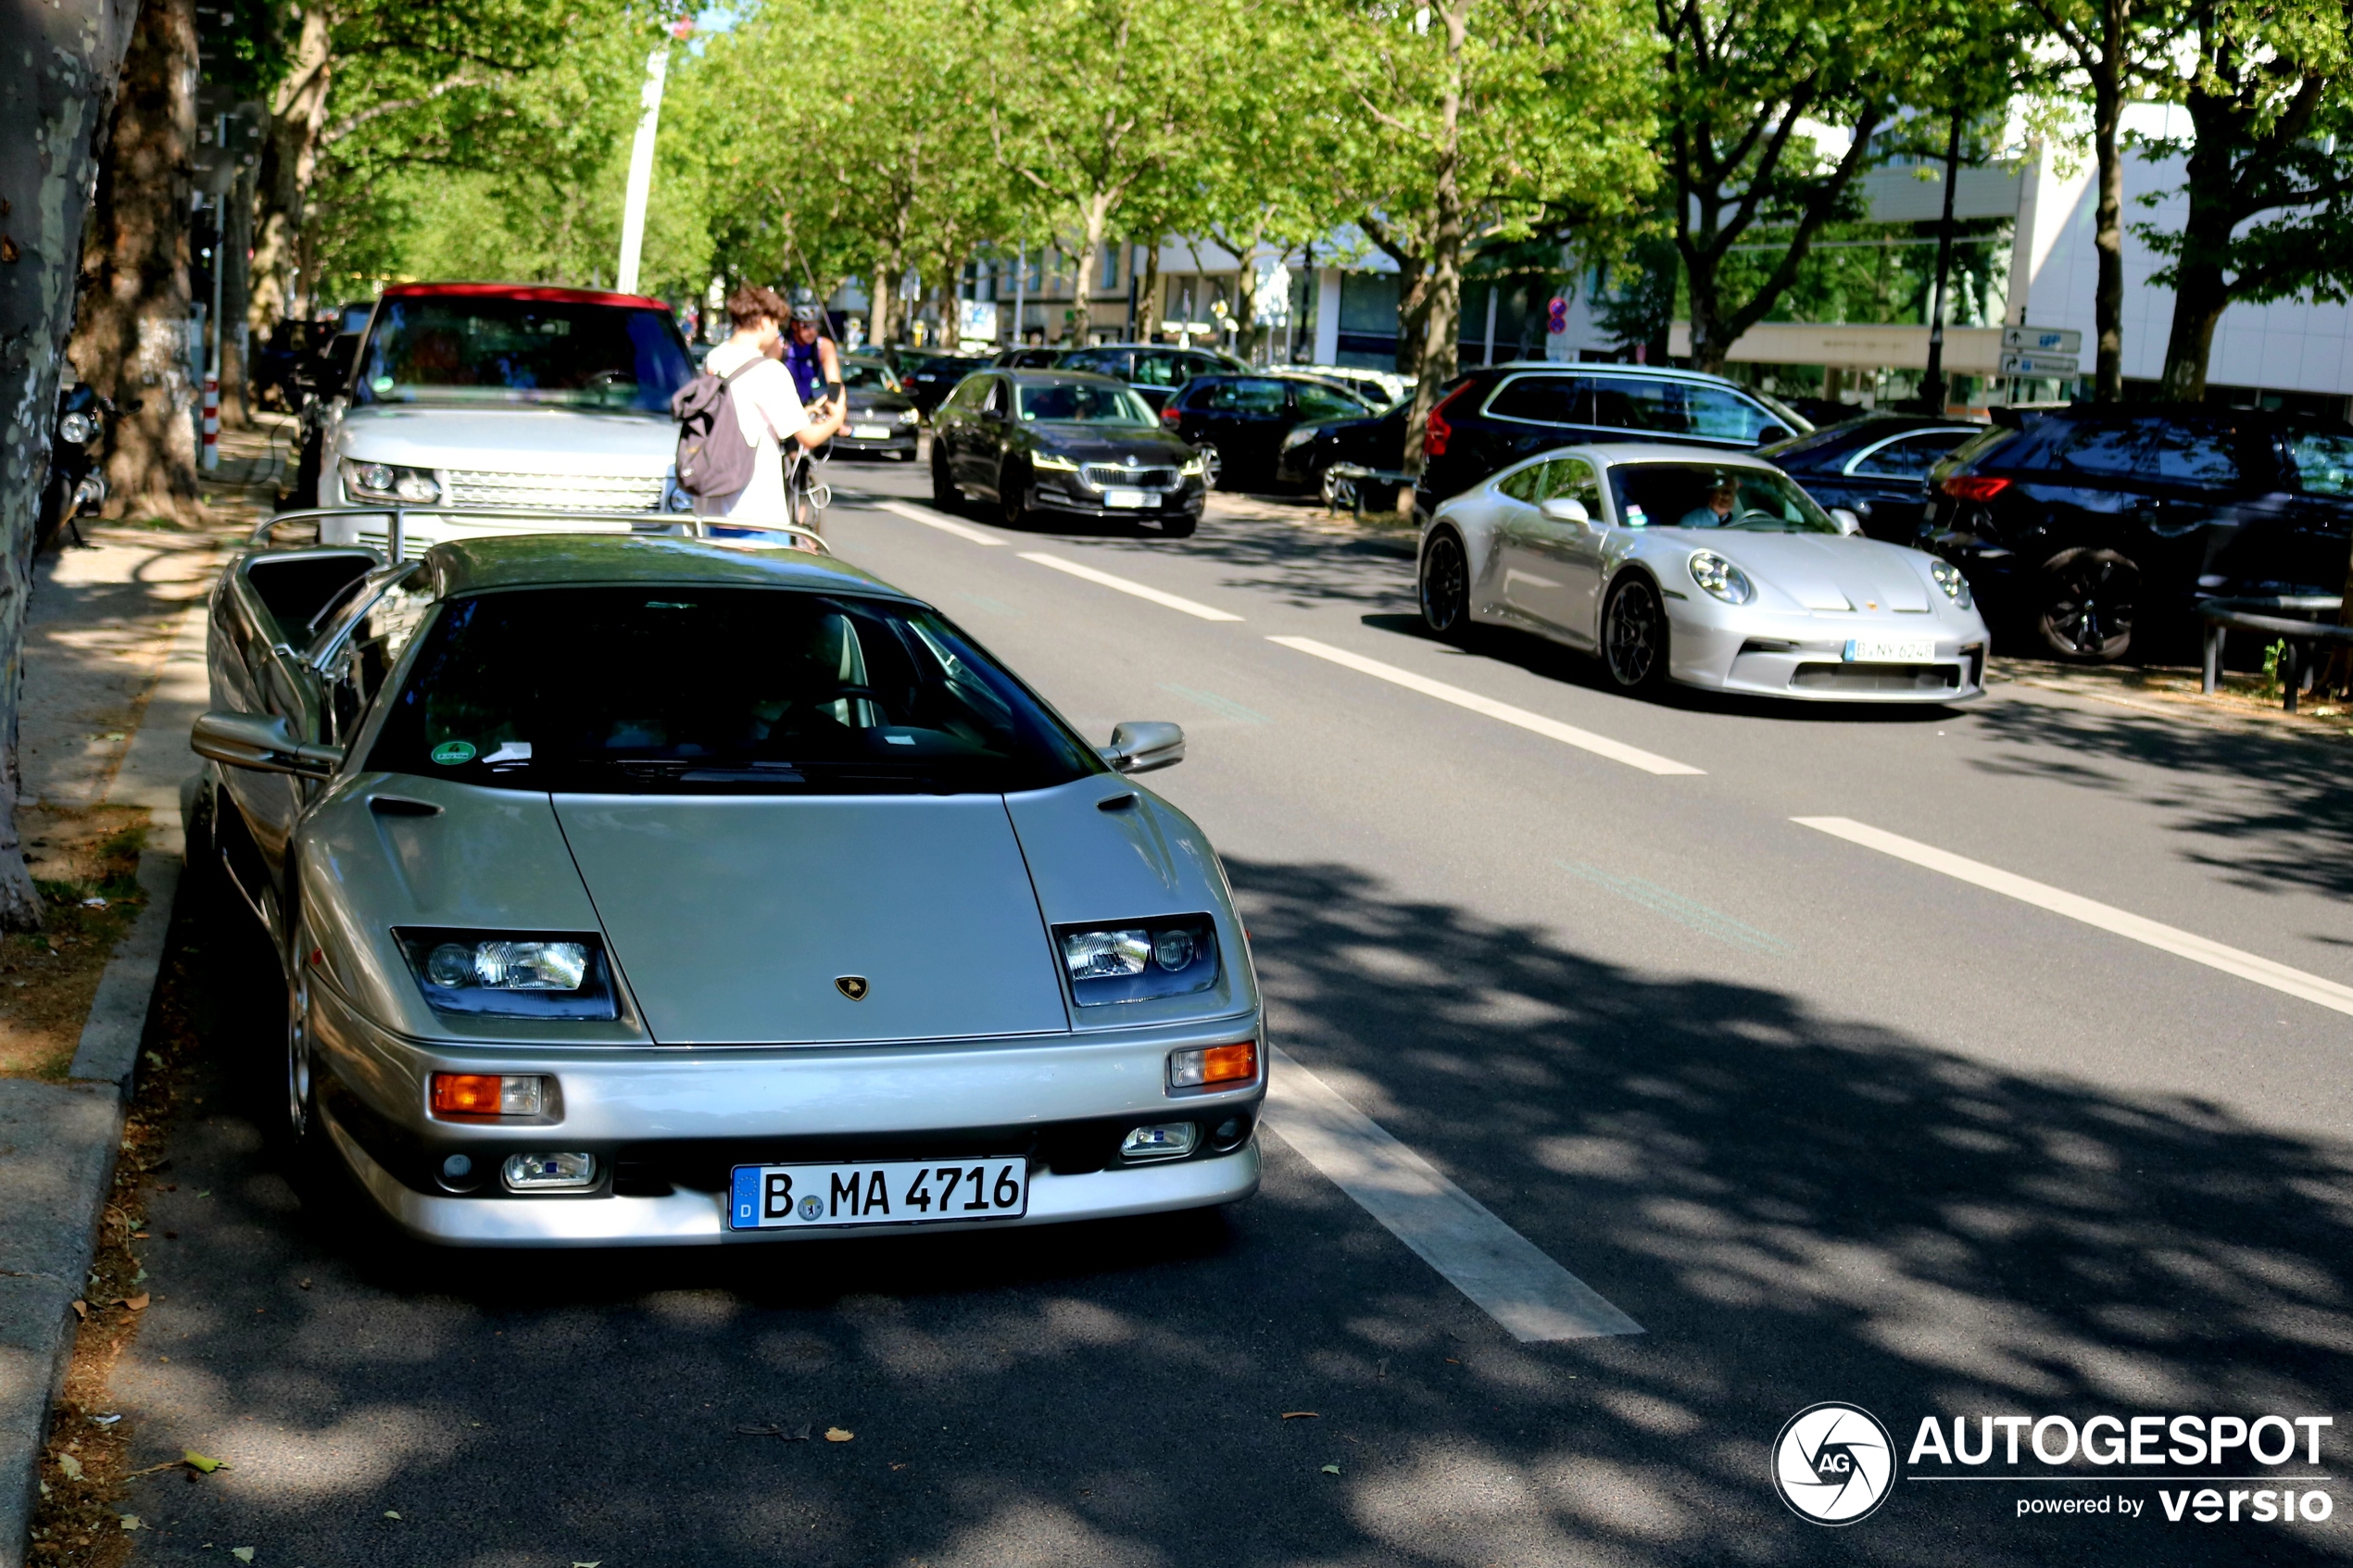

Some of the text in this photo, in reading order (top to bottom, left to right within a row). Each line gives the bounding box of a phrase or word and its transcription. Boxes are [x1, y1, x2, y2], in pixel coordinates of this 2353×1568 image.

[1856, 642, 1866, 658] B
[764, 1164, 1020, 1219] B MA 4716
[740, 1204, 752, 1218] D
